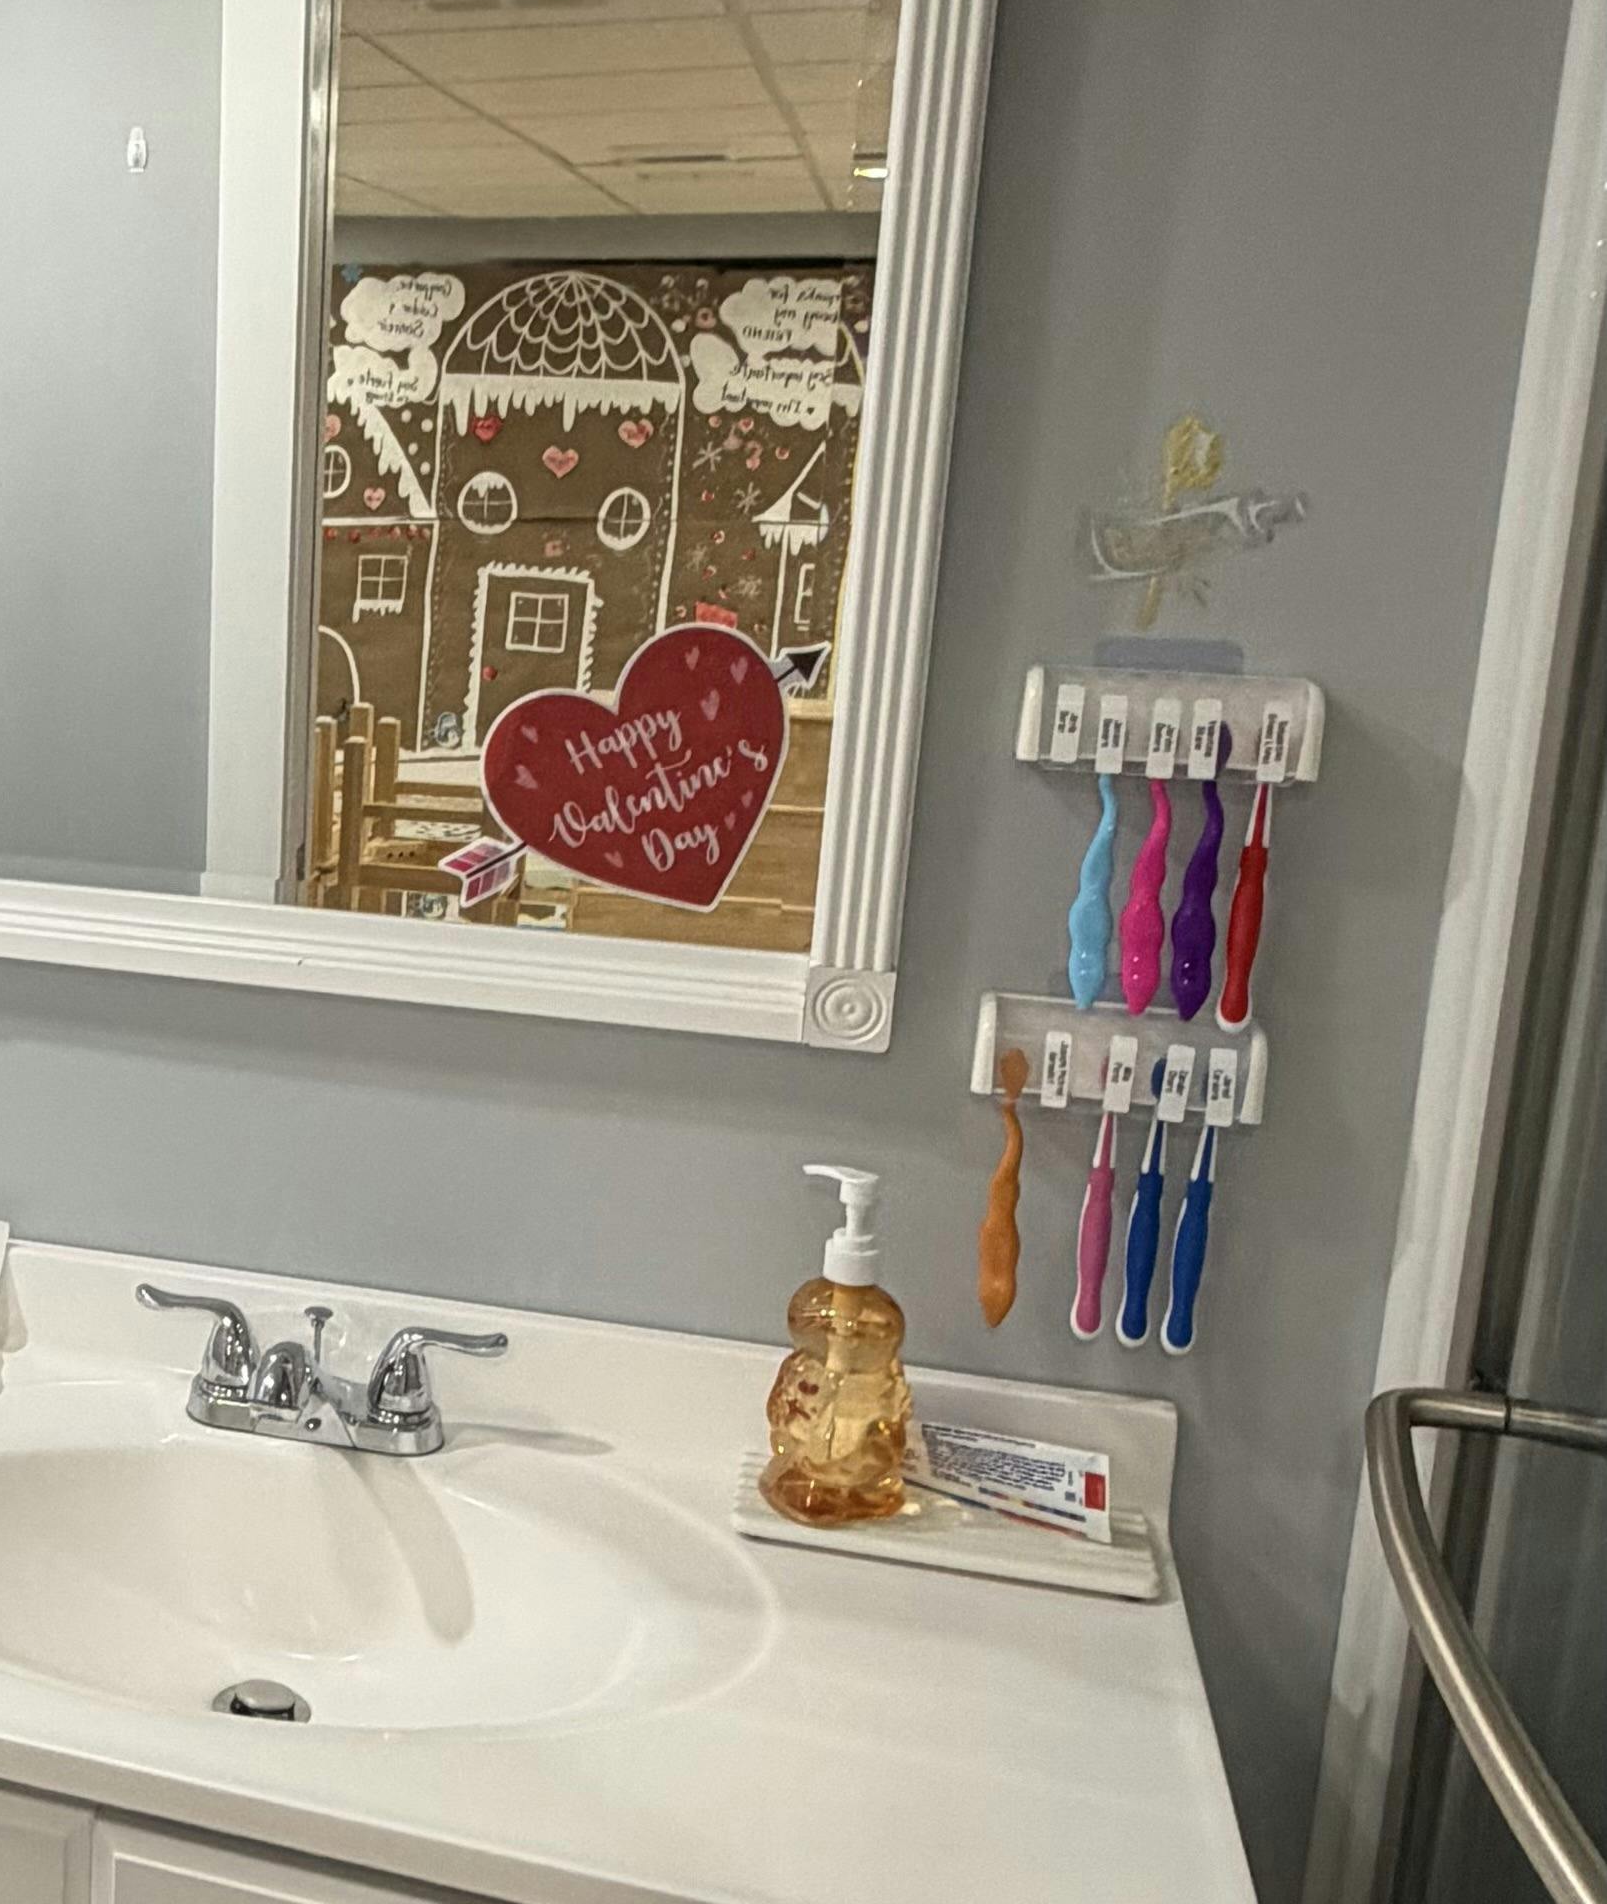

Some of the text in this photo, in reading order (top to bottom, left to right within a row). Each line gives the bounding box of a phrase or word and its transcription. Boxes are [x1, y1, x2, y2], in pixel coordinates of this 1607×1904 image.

[565, 709, 682, 774] Happy
[548, 738, 769, 849] Valentine's
[640, 822, 720, 873] Day
